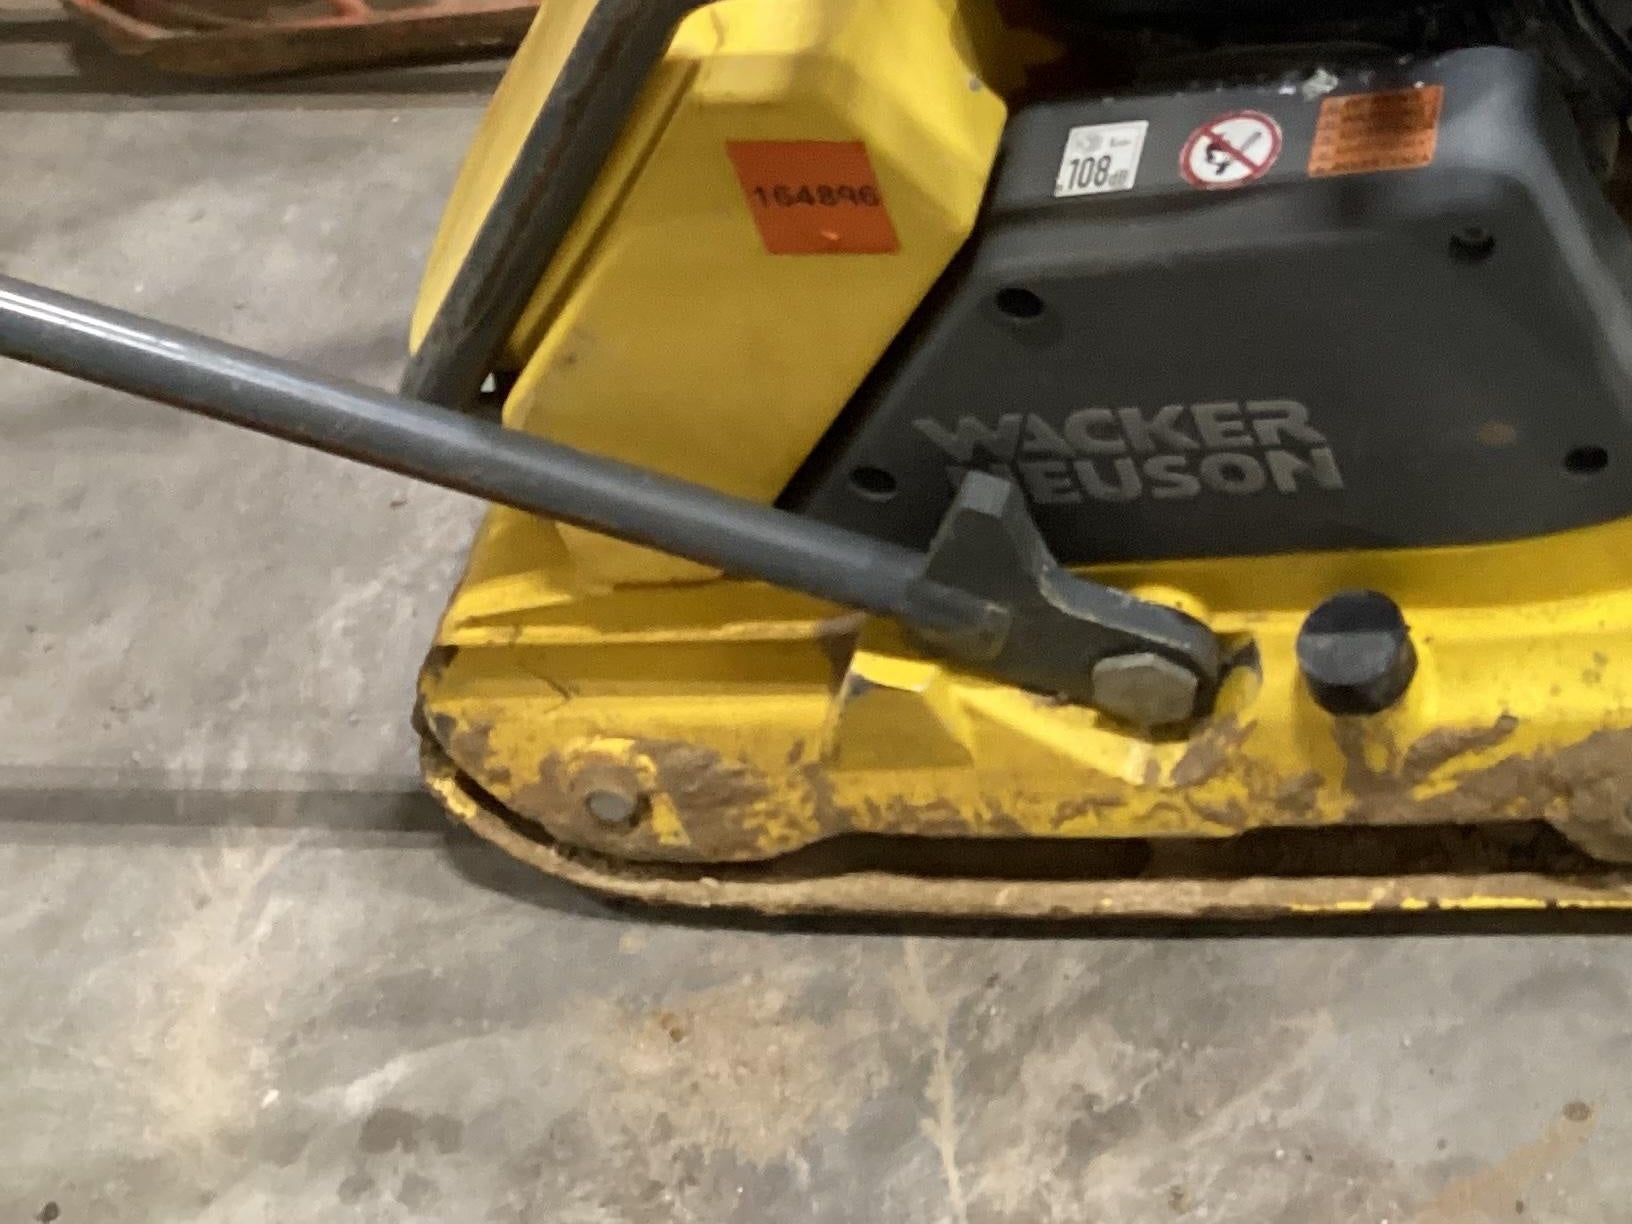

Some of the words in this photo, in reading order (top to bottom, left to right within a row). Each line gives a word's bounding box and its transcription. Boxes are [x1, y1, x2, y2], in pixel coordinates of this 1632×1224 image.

[1068, 155, 1111, 189] 108
[912, 400, 1327, 462] WACKER
[945, 447, 1344, 505] EUSON
